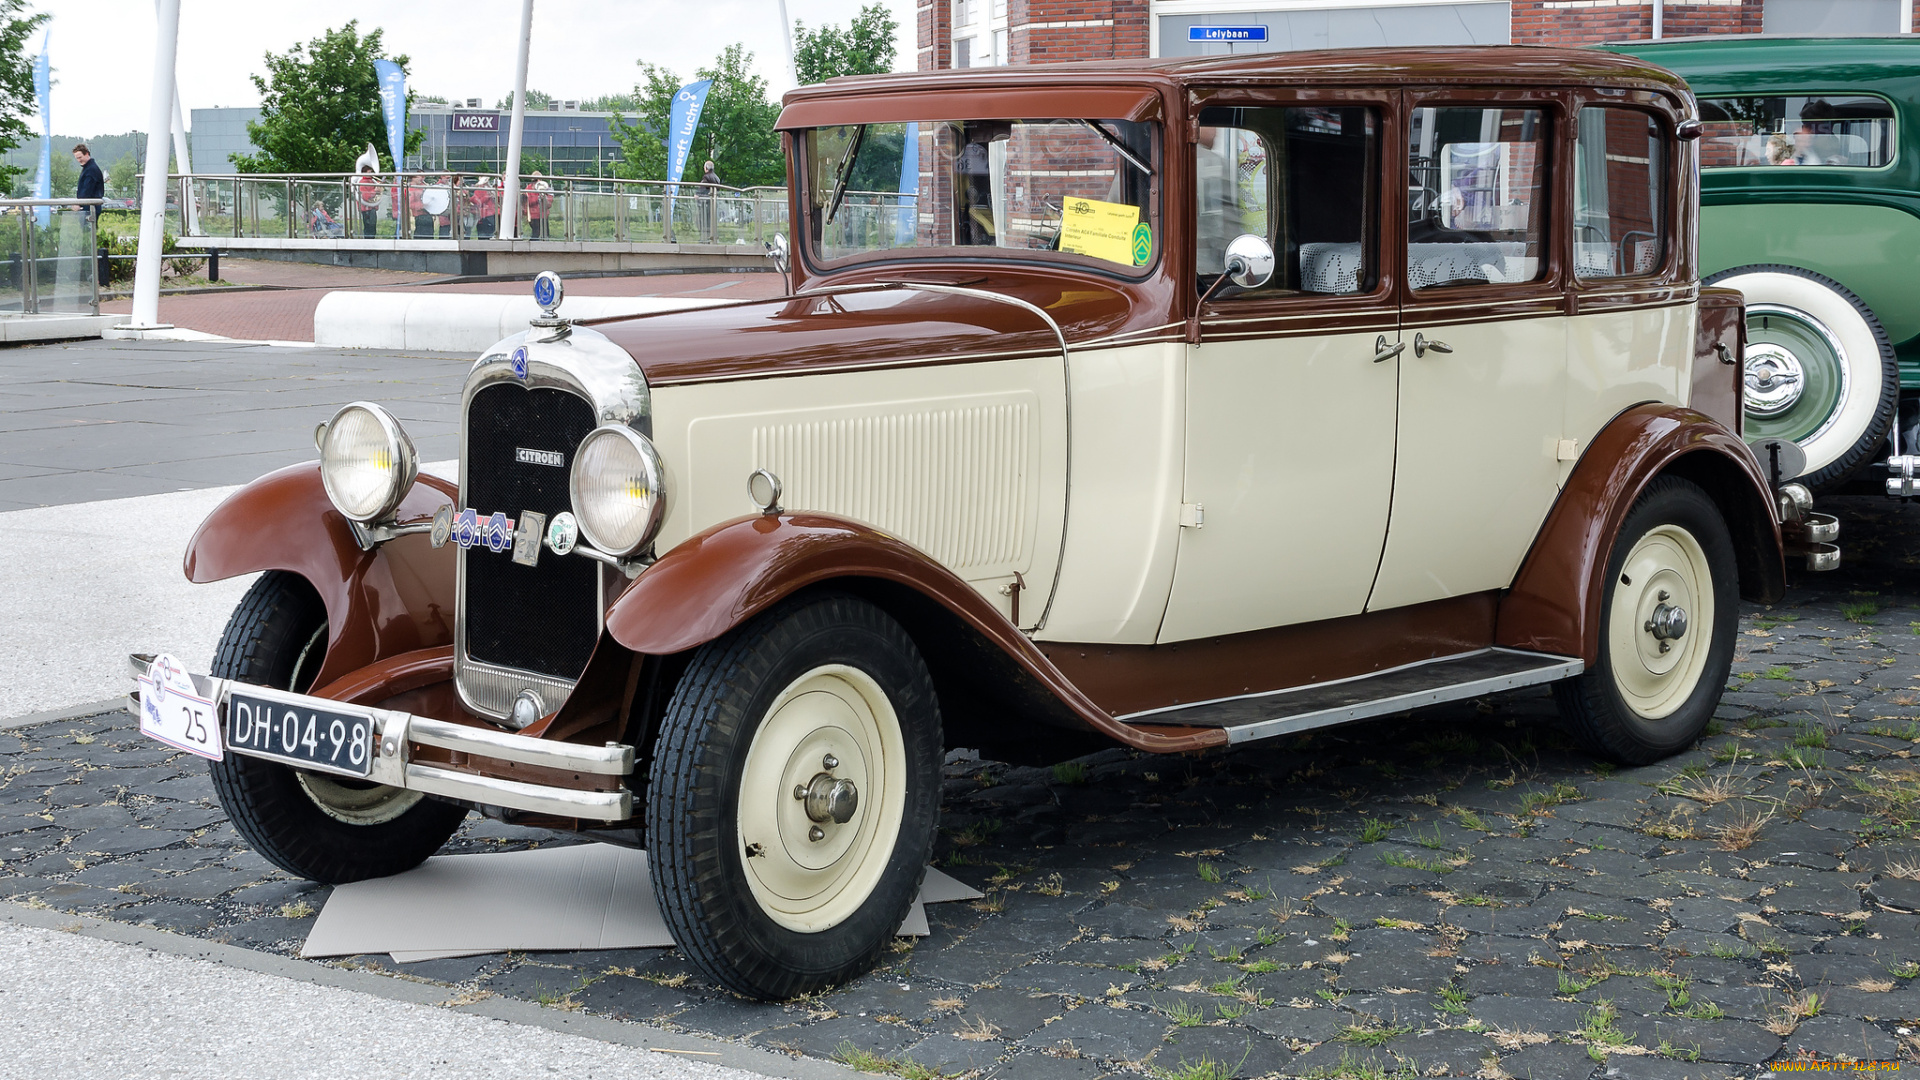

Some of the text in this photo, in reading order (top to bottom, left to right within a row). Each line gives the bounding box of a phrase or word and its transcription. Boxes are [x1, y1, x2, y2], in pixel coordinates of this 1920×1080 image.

[1206, 29, 1249, 40] Lelybaan
[680, 102, 700, 136] lucht
[183, 706, 207, 744] 25
